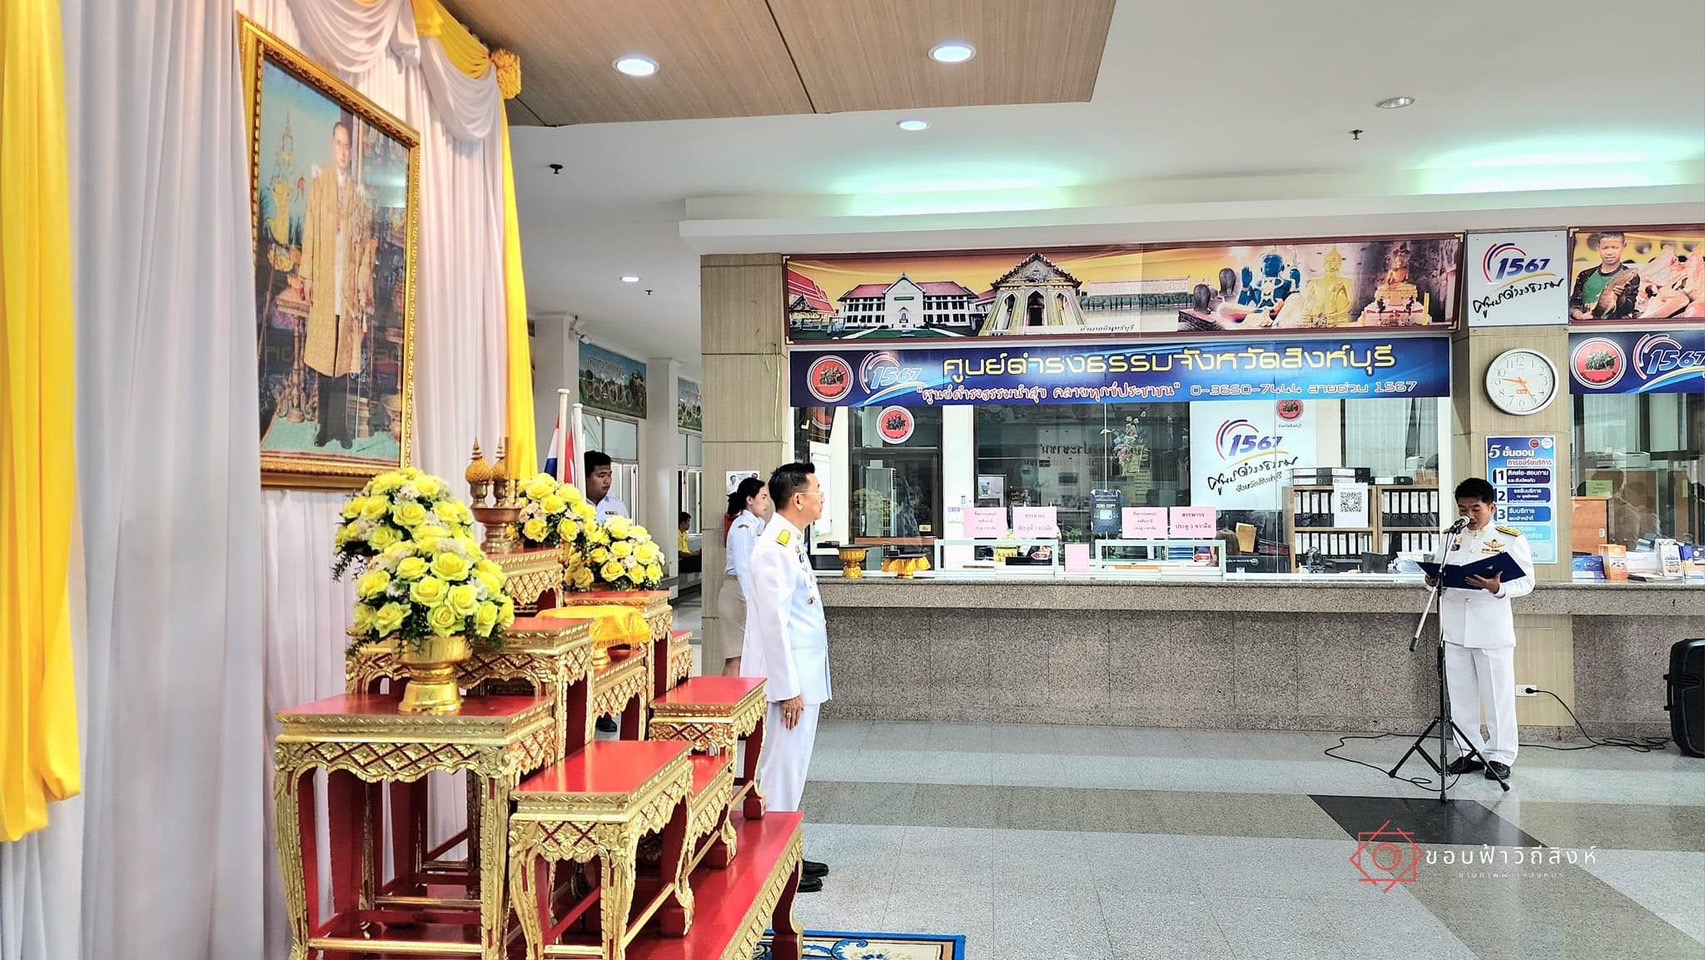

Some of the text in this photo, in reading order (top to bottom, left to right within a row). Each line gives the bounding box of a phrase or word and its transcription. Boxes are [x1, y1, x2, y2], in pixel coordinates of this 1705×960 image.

[1496, 258, 1550, 280] 1567
[943, 343, 1397, 382] ศูนย์ดำรงธรรมจังหวัดสิงห์บุรี
[871, 367, 921, 389] 1567
[1374, 380, 1418, 393] 1567
[1229, 434, 1283, 456] 1567
[1489, 444, 1535, 458] 5 ขั้นตอน
[1497, 470, 1504, 481] 1
[1497, 490, 1506, 501] 2
[1497, 508, 1506, 520] 3
